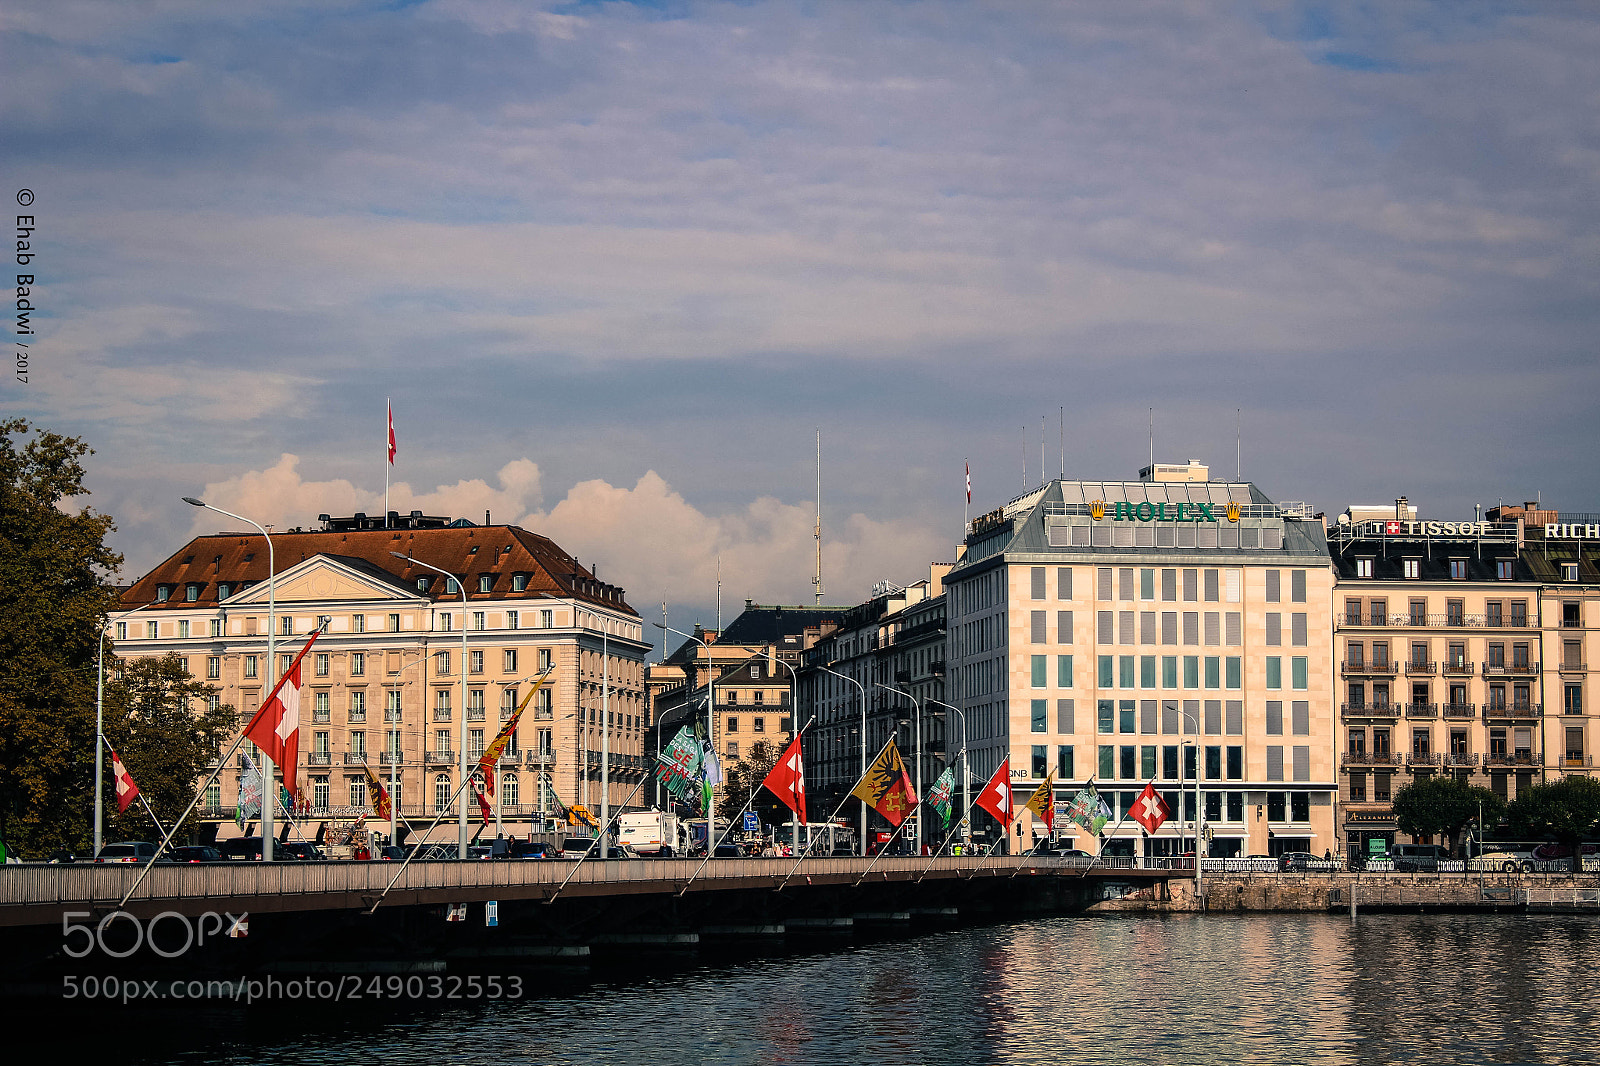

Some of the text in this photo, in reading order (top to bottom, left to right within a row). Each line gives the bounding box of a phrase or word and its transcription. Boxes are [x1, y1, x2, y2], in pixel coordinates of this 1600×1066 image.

[1114, 501, 1217, 522] ROLEX
[1403, 521, 1490, 536] TISSOT
[1544, 523, 1600, 538] RICH
[669, 739, 682, 751] DES
[673, 749, 694, 767] GÉ
[656, 764, 673, 782] TS
[668, 762, 689, 780] AN
